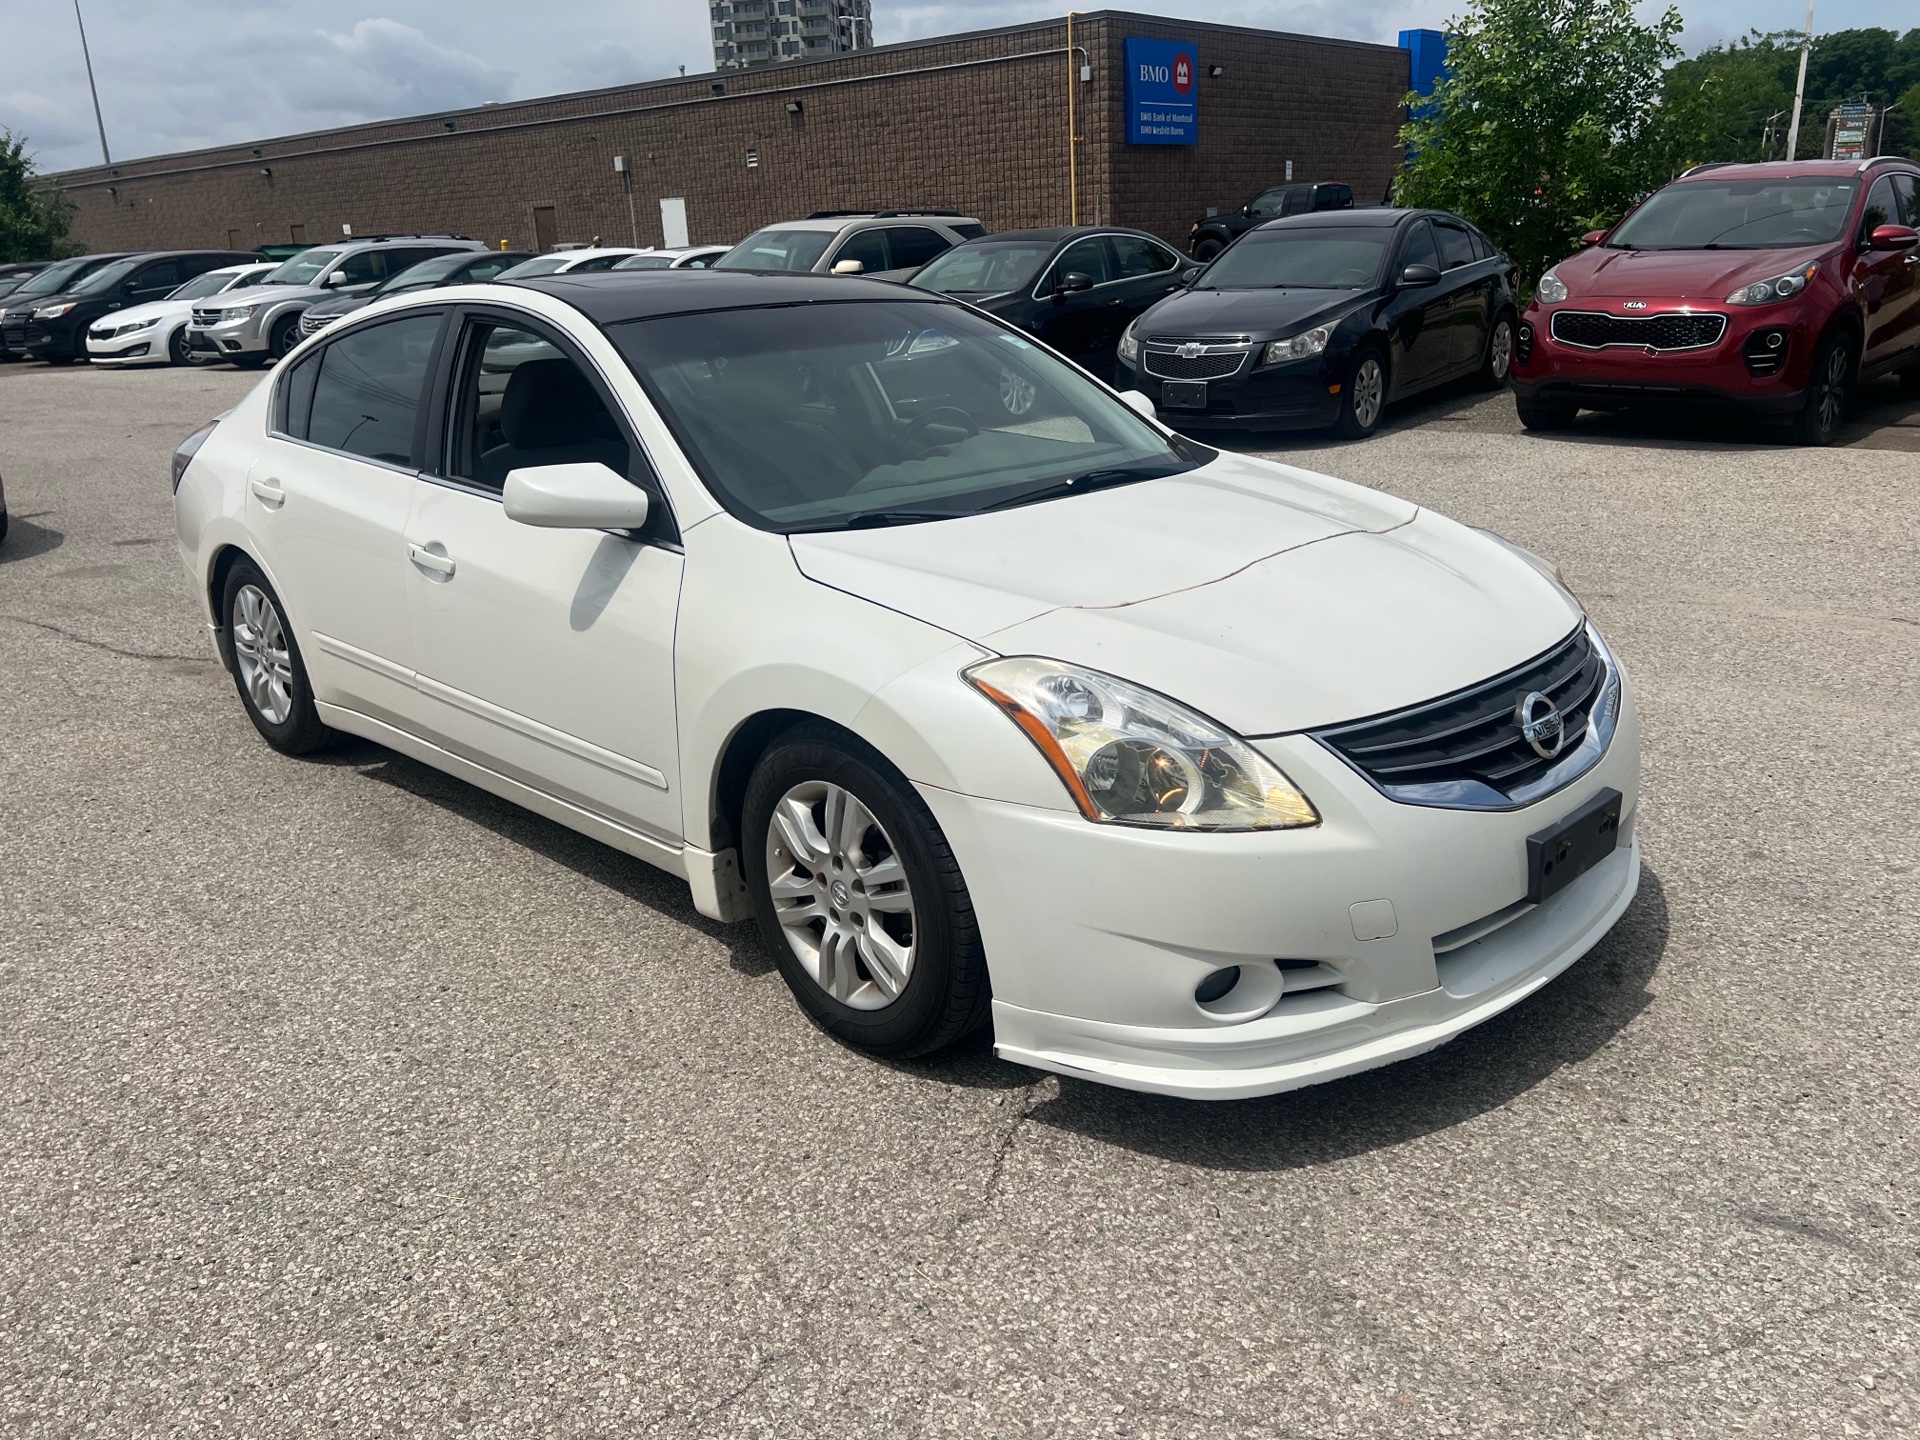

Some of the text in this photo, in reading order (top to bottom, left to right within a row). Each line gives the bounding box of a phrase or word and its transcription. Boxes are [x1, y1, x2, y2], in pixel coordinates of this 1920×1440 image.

[1140, 64, 1169, 83] BMO
[1140, 111, 1193, 123] BMO Bank of Montreal
[1140, 125, 1185, 136] BMO Nesbitt Burns
